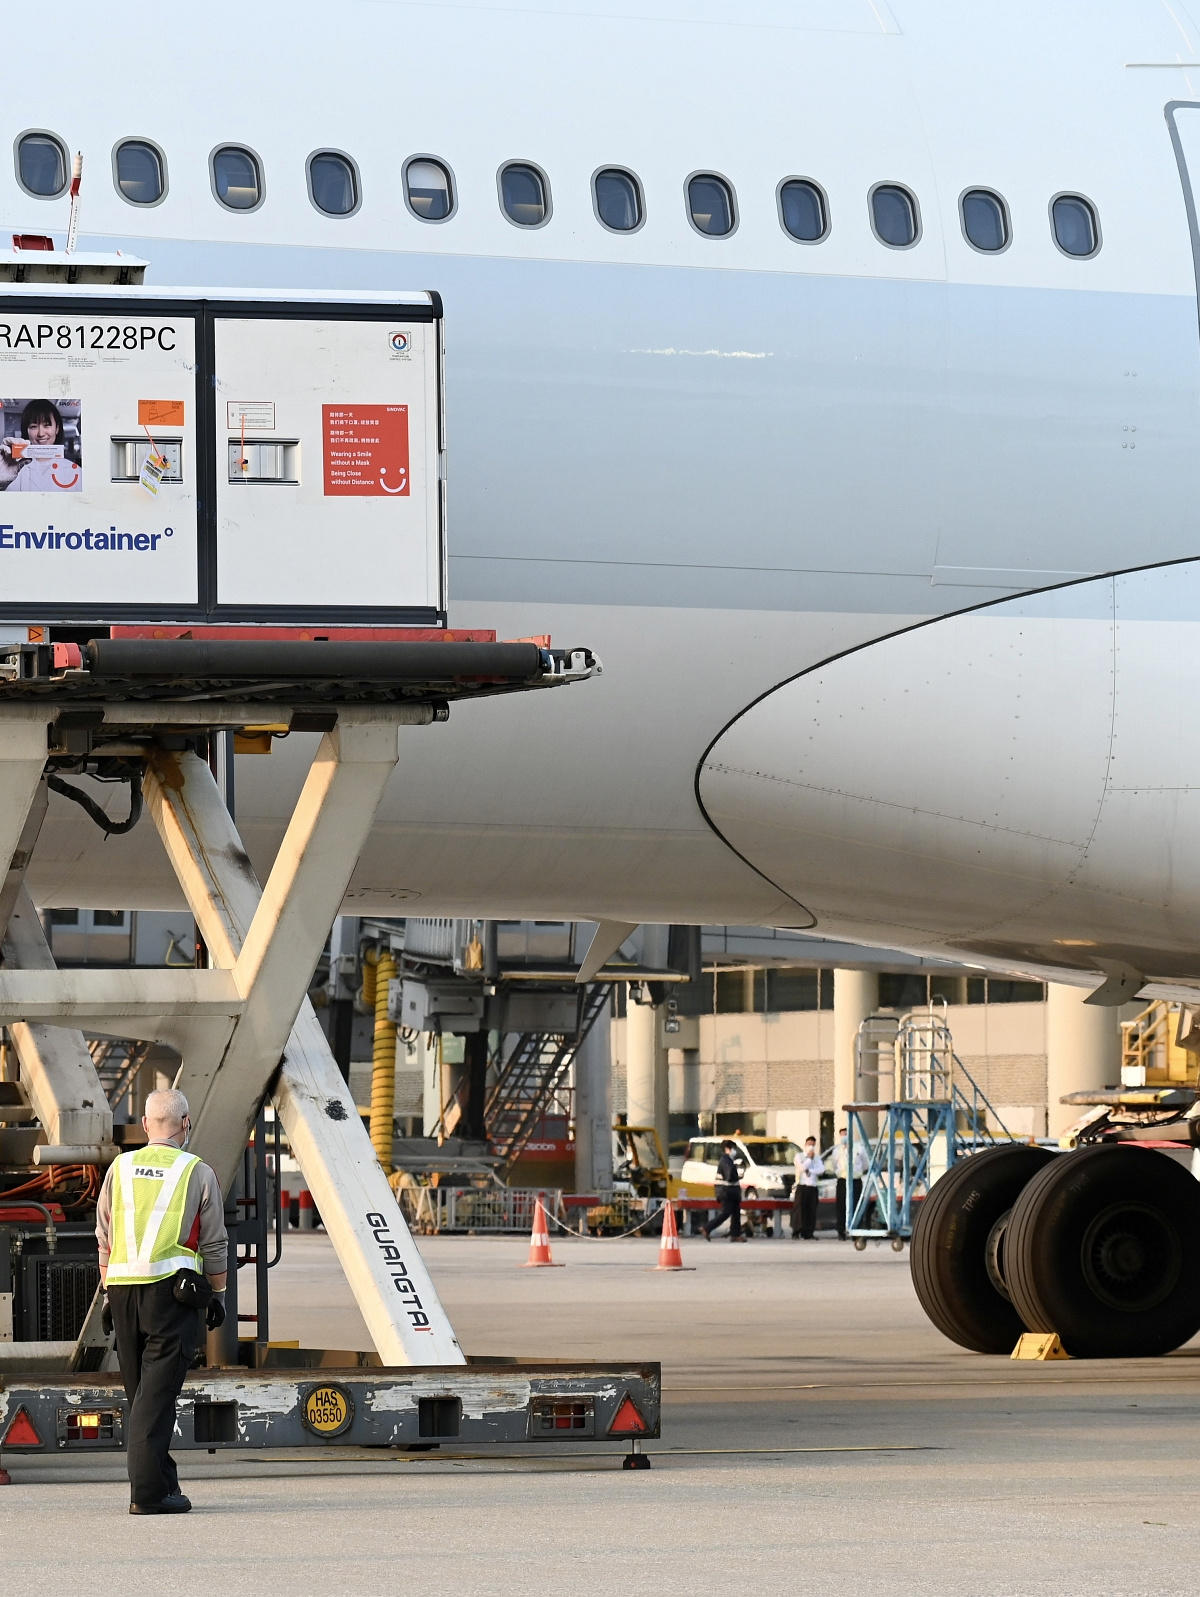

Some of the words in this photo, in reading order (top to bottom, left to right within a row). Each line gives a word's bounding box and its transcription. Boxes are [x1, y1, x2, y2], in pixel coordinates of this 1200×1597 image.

[135, 1168, 164, 1177] HAS
[365, 1212, 432, 1332] GUANGTAI
[315, 1391, 338, 1407] HAS
[310, 1408, 342, 1424] 03550
